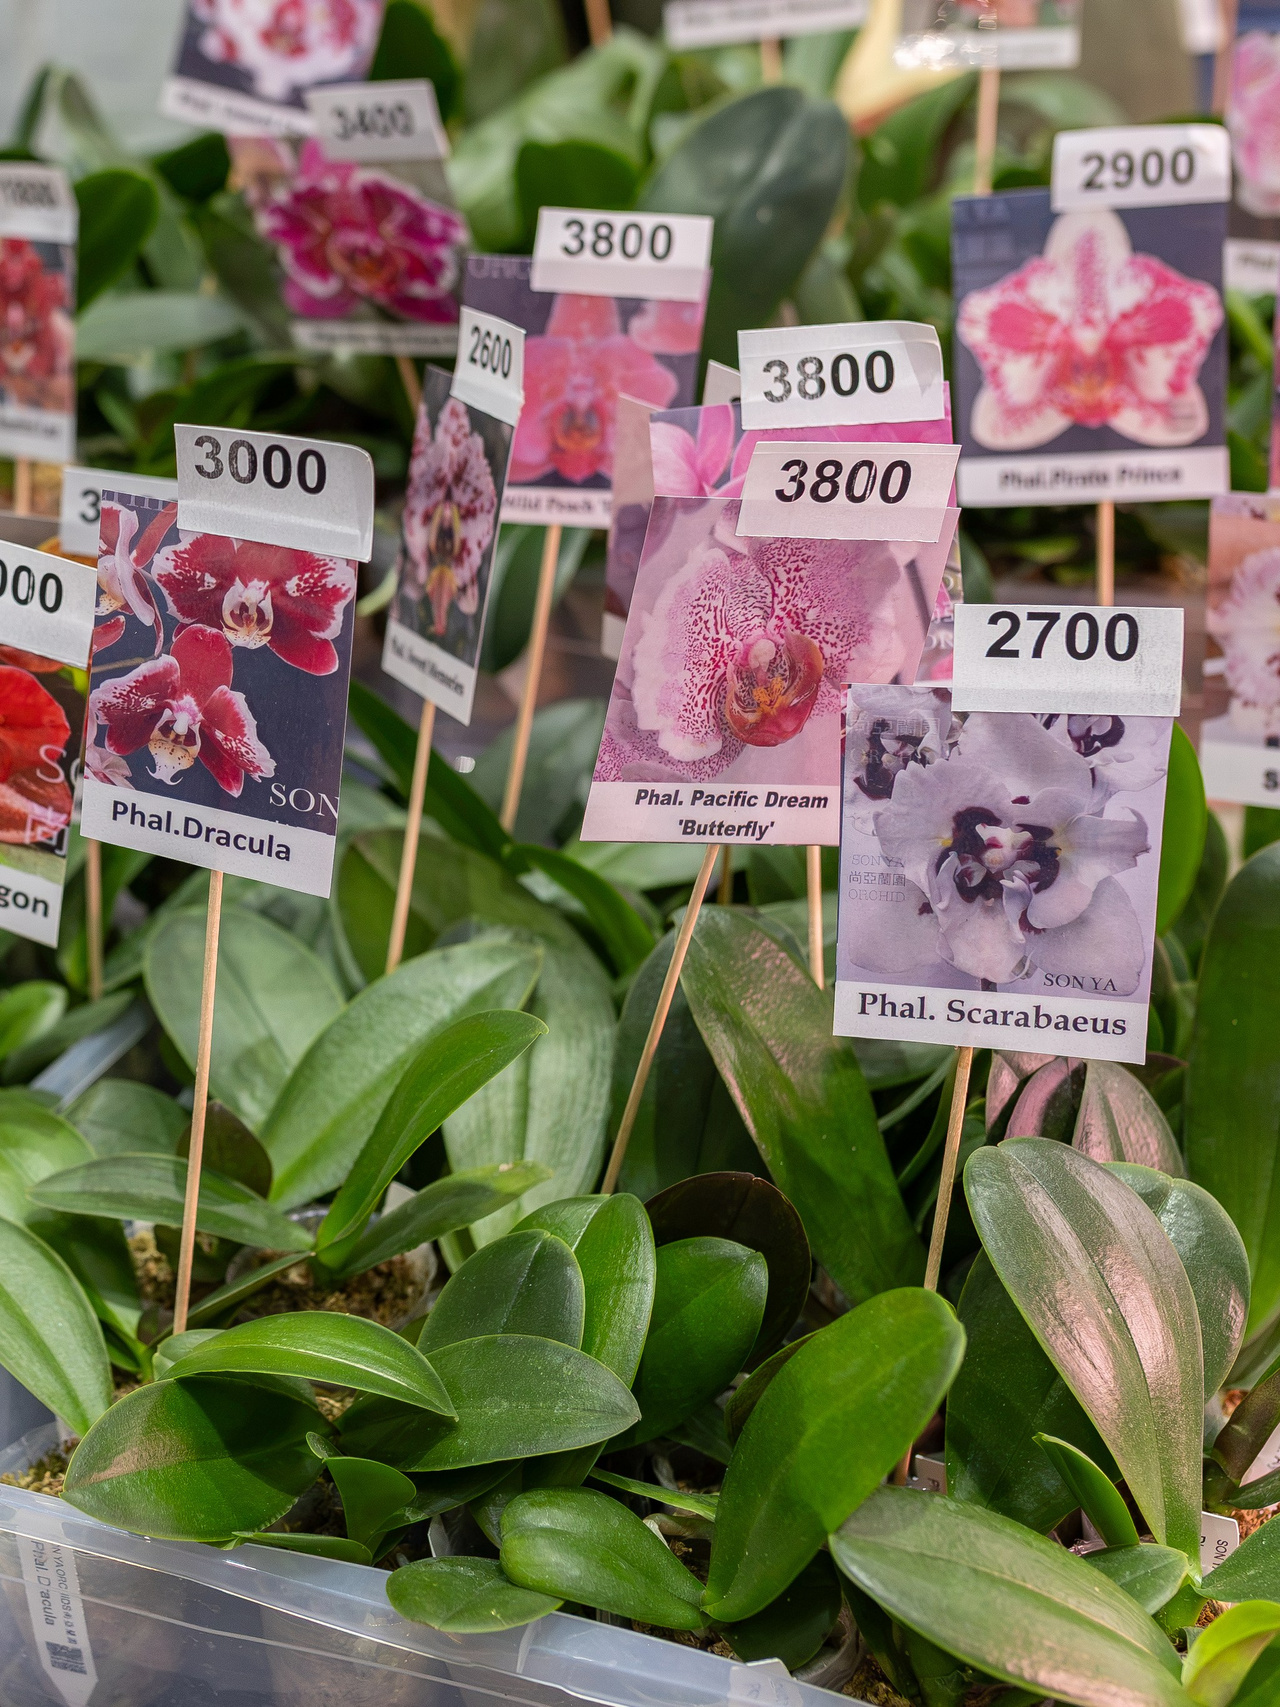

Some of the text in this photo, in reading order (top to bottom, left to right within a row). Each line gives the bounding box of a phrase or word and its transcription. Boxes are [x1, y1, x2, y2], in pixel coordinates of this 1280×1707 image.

[1081, 147, 1195, 191] 2900
[562, 218, 673, 261] 3800
[470, 325, 512, 380] 2600
[762, 350, 895, 403] 3800
[193, 434, 328, 496] 3000
[774, 459, 912, 504] 3800
[985, 610, 1140, 662] 2700
[269, 782, 339, 819] SON
[634, 788, 829, 809] Phal. Pacific Dream
[111, 799, 291, 862] Phal.Dracula
[678, 819, 775, 841] 'Butterfly'
[851, 854, 881, 867] SON
[848, 888, 906, 903] ORCHID
[1043, 972, 1118, 992] SON YA
[857, 991, 1127, 1036] Phal. Scarabaeus
